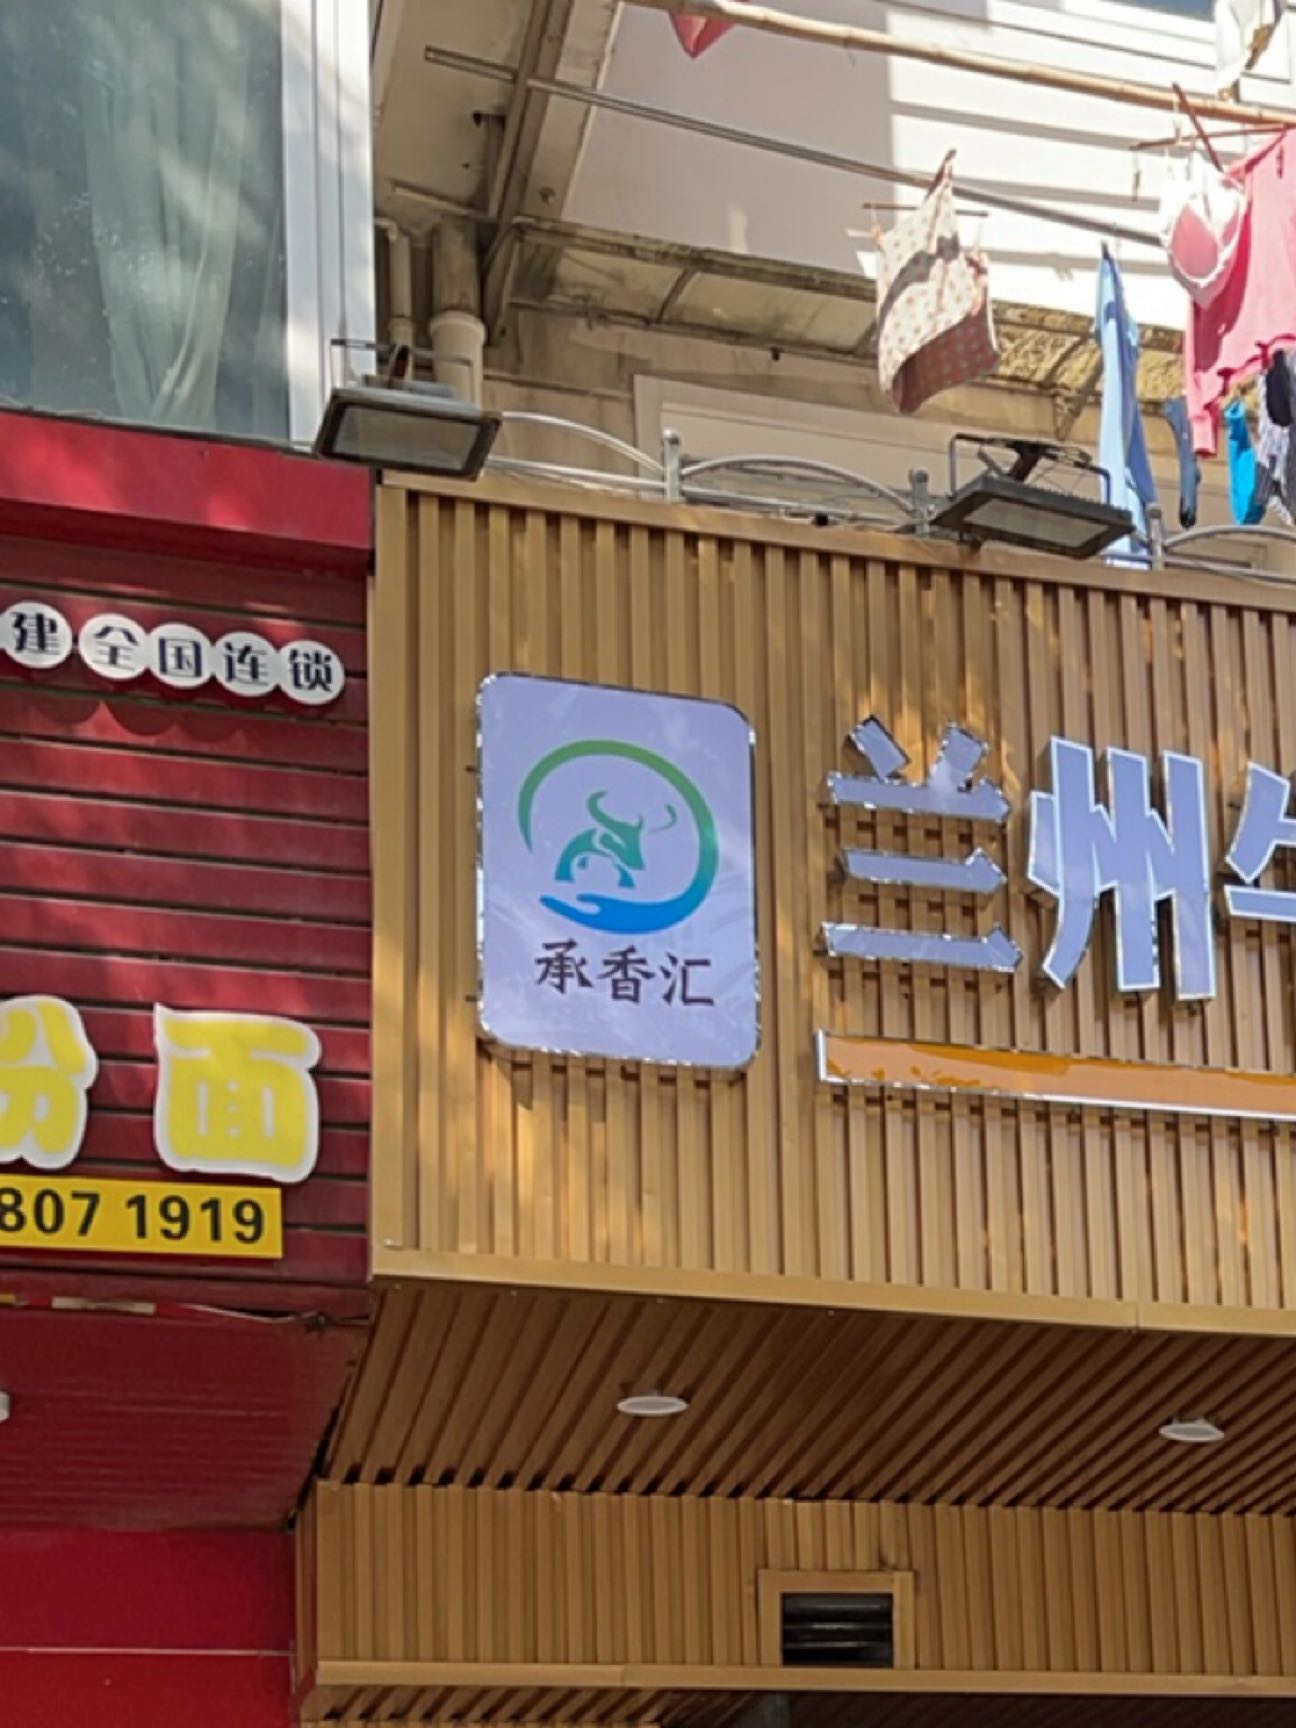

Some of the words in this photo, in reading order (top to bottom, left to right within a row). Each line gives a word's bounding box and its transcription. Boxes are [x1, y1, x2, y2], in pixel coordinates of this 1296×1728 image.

[13, 611, 333, 692] 建全国连锁
[535, 938, 715, 1007] 承香汇
[125, 1194, 265, 1244] 1919
